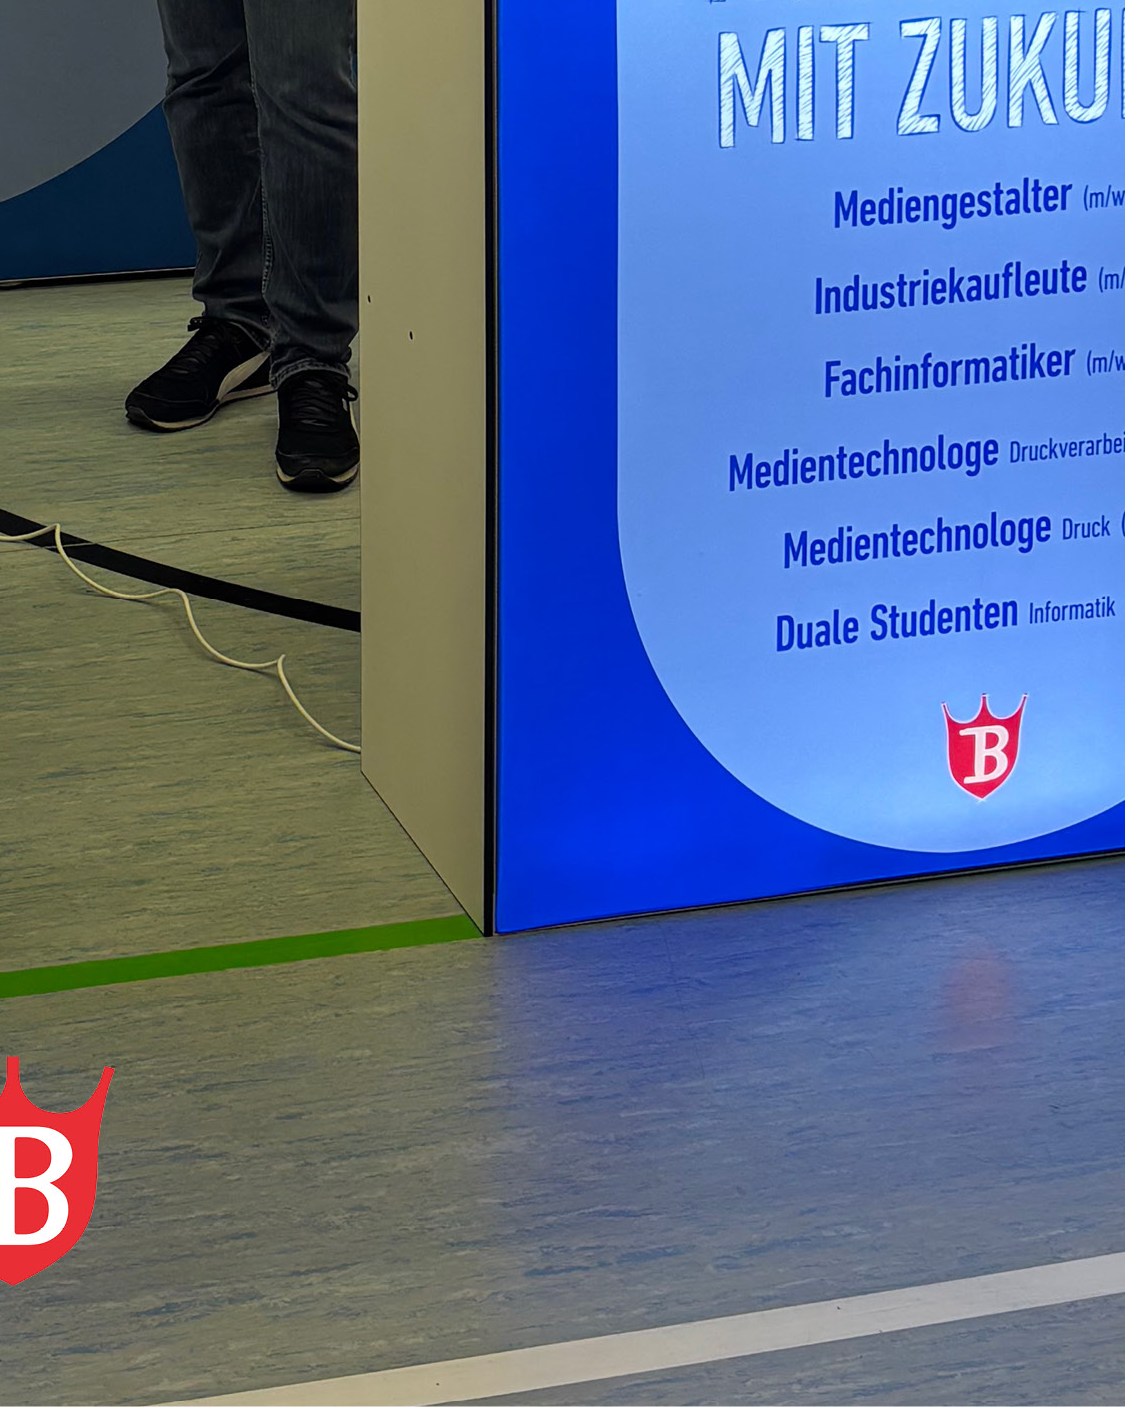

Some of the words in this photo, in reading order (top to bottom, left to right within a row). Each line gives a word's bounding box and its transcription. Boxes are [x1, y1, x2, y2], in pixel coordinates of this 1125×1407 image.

[718, 22, 872, 148] MIT
[896, 7, 1125, 136] ZUKU
[834, 177, 1073, 230] Mediengestalter
[1083, 184, 1125, 212] (m/w
[815, 260, 1088, 315] Industriekaufleute
[825, 343, 1076, 398] Fachinformatiker
[729, 434, 1000, 492] Medientechnologe
[783, 511, 1051, 569] Medientechnologe
[1062, 515, 1111, 540] Druck
[776, 609, 859, 652] Duale
[870, 597, 1019, 641] Studenten
[1029, 596, 1115, 625] Informatik
